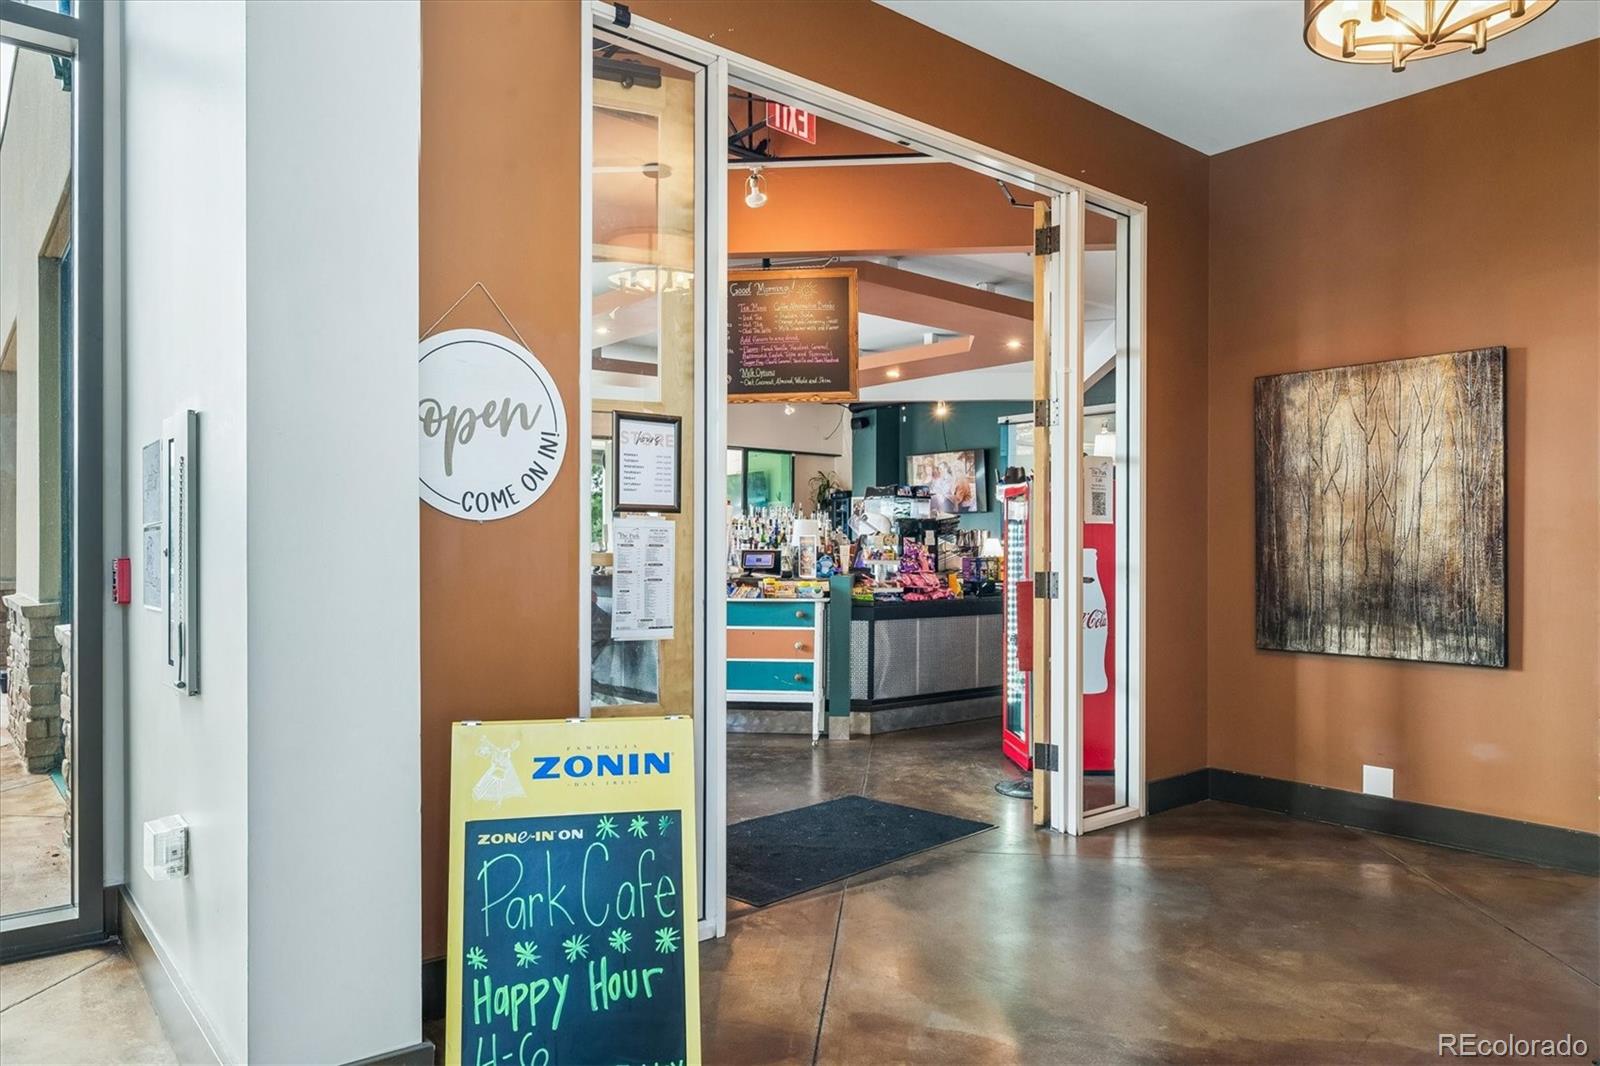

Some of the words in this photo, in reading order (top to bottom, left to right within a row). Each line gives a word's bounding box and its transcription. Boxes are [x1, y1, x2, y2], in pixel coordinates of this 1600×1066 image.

[729, 282, 753, 296] Good
[418, 397, 542, 477] open
[461, 484, 520, 513] COME
[520, 460, 549, 492] ON
[537, 430, 560, 460] IN!
[532, 752, 670, 780] ZONIN
[558, 829, 584, 840] ON
[477, 850, 575, 936] Park
[582, 842, 676, 927] Cafe
[473, 974, 569, 1031] Happy
[589, 955, 664, 1012] Hour
